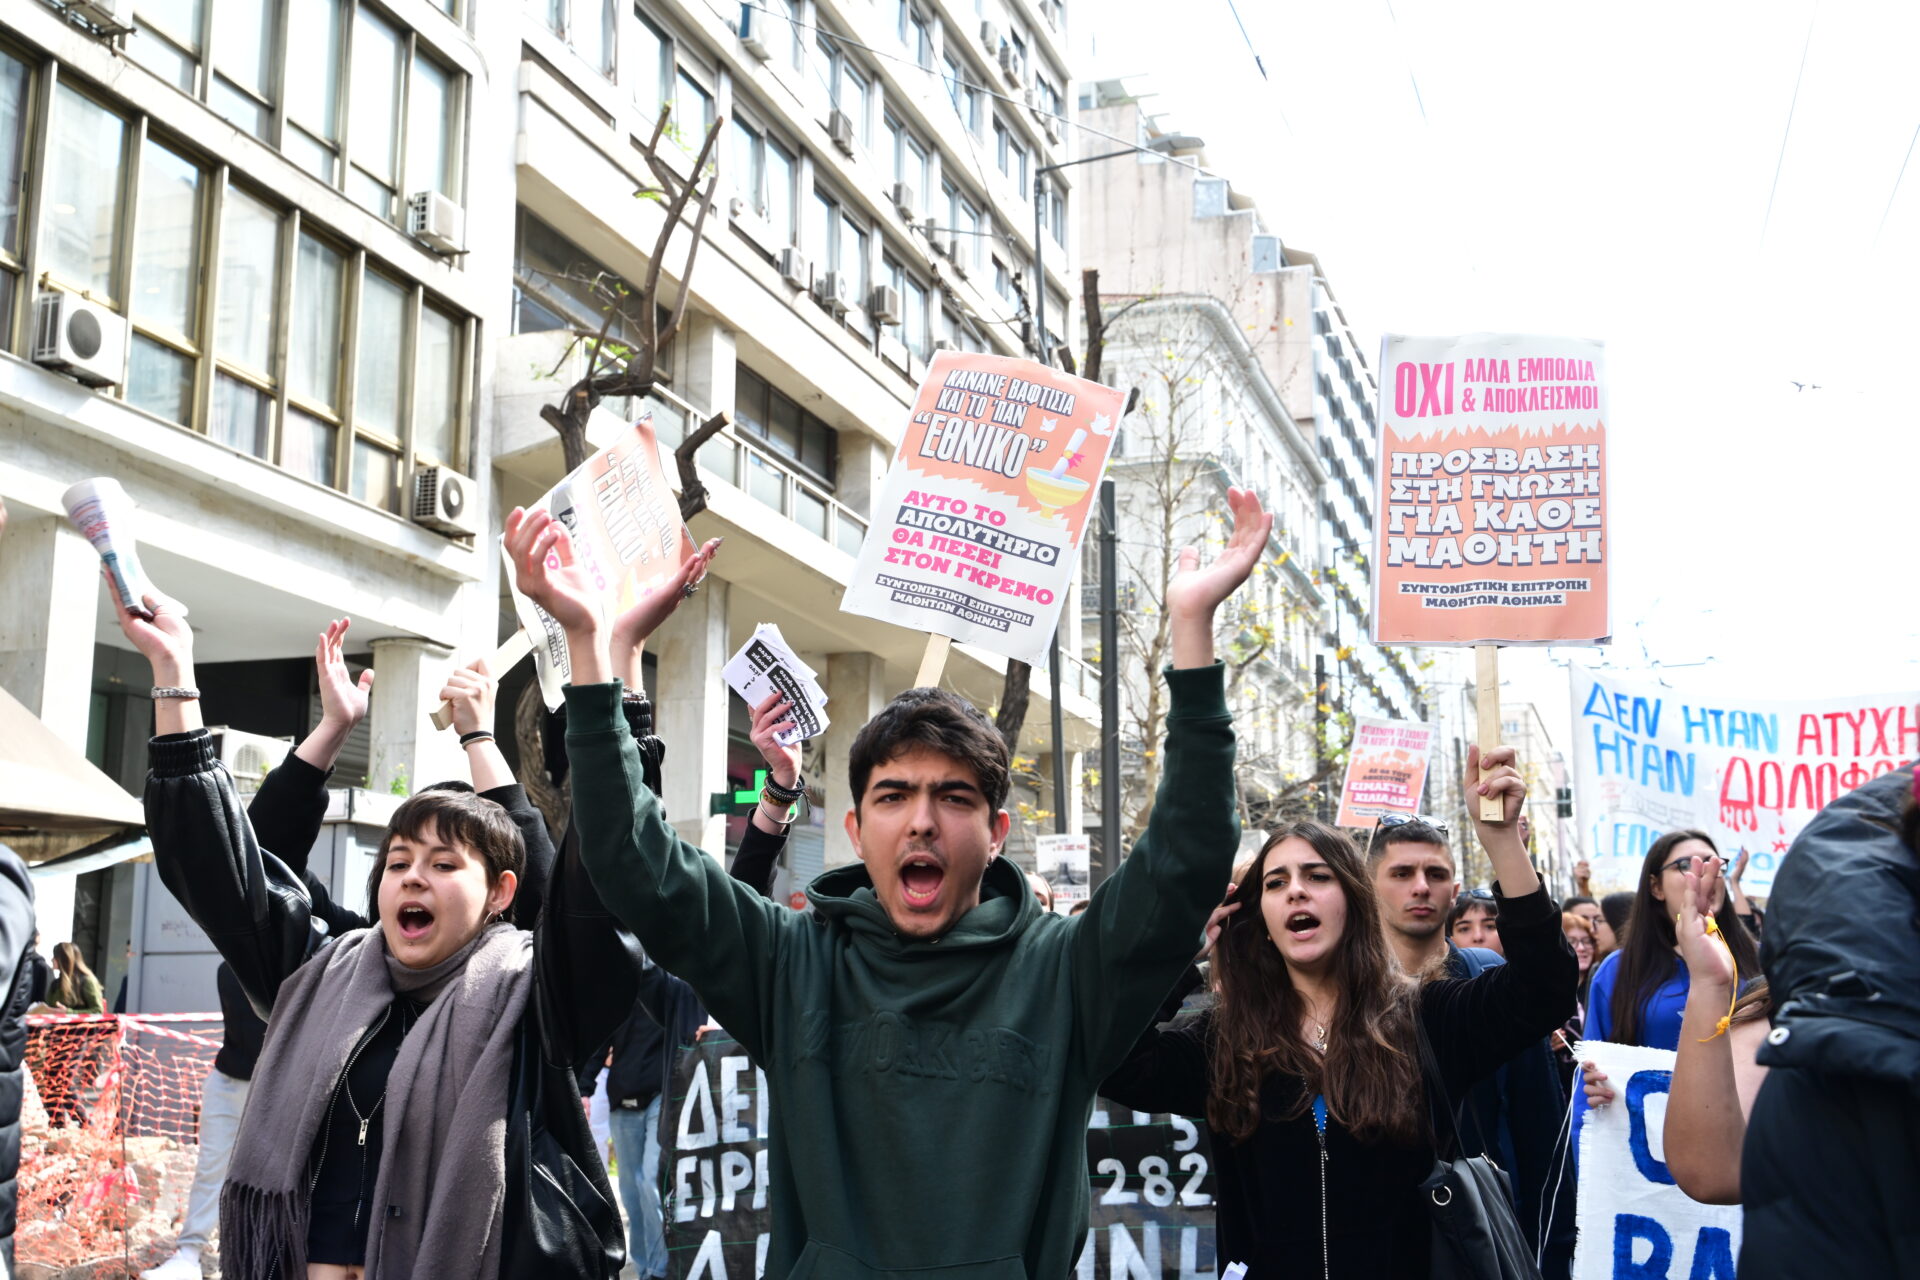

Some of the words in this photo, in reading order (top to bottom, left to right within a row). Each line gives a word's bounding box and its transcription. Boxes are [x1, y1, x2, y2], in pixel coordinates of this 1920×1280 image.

[1464, 358, 1510, 383] ΑΛΛΑ
[1518, 358, 1595, 383] ΕΜΠΟΔΙΑ
[936, 388, 959, 412] ΚΑΙ
[966, 393, 988, 418] ΤΟ
[944, 369, 1007, 397] ΚΑΝΑΝΕ
[1007, 378, 1076, 416] ΒΑΦΤΙΣΙΑ
[1395, 362, 1455, 418] ΟΧΙ
[1461, 387, 1475, 412] &
[1483, 386, 1599, 413] ΑΠΟΚΛΕΙΣΜΟΙ
[1391, 444, 1600, 477] ΠΡΟΣΒΑΣΗ
[1390, 476, 1463, 504] ΣΤΗ
[1471, 472, 1600, 500] ΓΝΩΣΗ
[903, 490, 967, 514] ΑΥΤΟ
[973, 504, 1006, 526] ΤΟ
[1388, 504, 1463, 535] ΓΙΑ
[1473, 498, 1600, 532] ΚΑΘΕ
[892, 528, 928, 547] ΘΑ
[929, 535, 1002, 569] ΠΕΣΕΙ
[898, 509, 1058, 563] ΑΠΟΛΥΤΗΡΙΟ
[1387, 531, 1602, 569] ΜΑΘΗΤΗ
[884, 548, 952, 574] ΣΤΟΝ
[954, 563, 1055, 605] ΓΚΡΕΜΟ
[1401, 582, 1508, 593] ΣΥΝΤΟΝΙΣΤΙΚΗ
[1511, 580, 1587, 592] ΕΠΙΤΡΟΠΗ
[877, 576, 967, 604] ΣΥΝΤΟΝΙΣΤΙΚΗ
[969, 598, 1031, 624] ΕΠΙΤΡΟΠΗ
[894, 592, 954, 614] ΜΑΘΗΤΩΝ
[956, 608, 1007, 630] ΑΘΗΝΑΣ
[1426, 595, 1498, 607] ΜΑΘΗΤΩΝ
[1501, 595, 1562, 606] ΑΘΗΝΑΣ
[1583, 682, 1661, 738] ΔΕΝ
[1682, 705, 1779, 754] ΗΤΑΝ
[1593, 724, 1695, 797] ΗΤΑΝ
